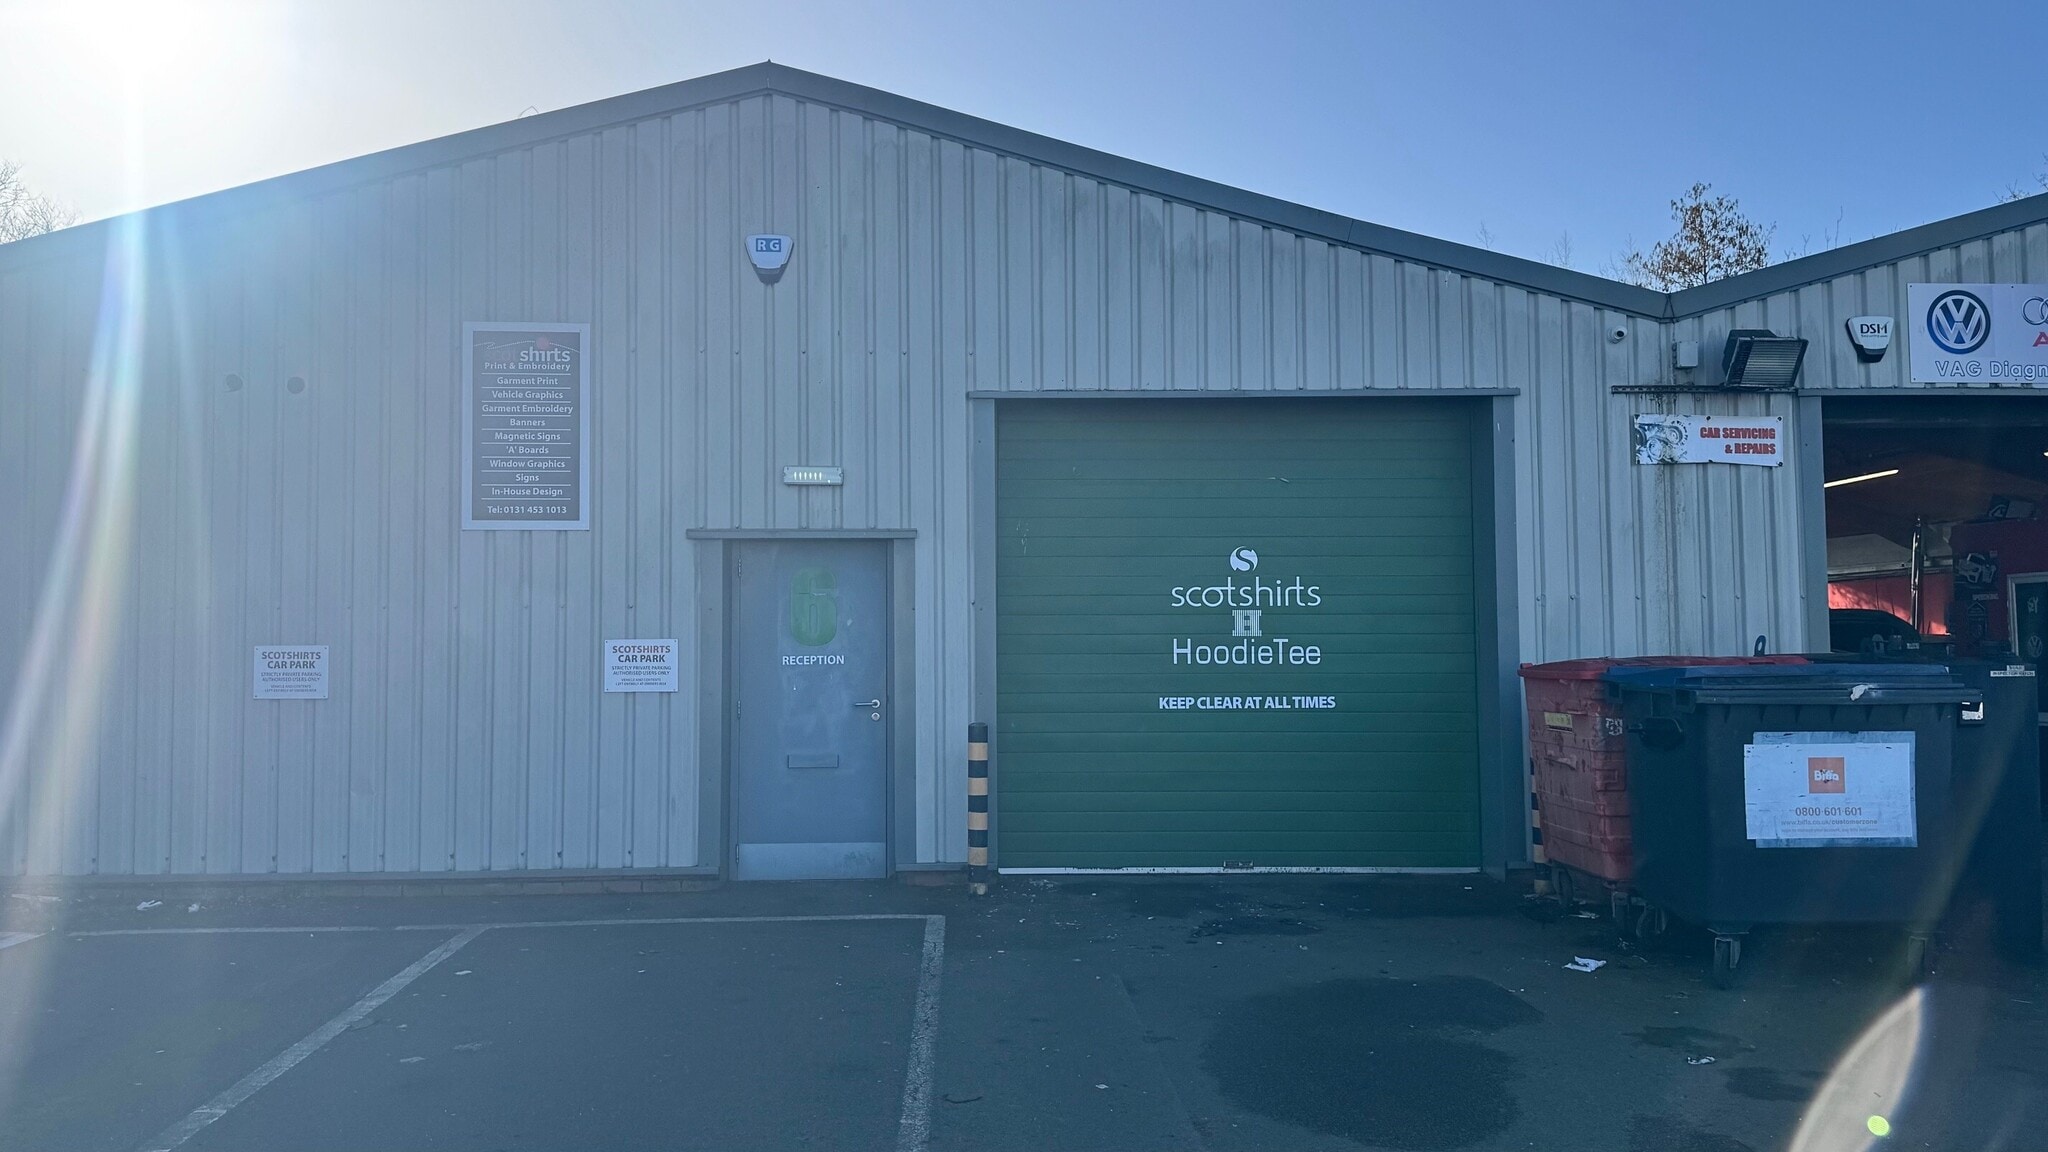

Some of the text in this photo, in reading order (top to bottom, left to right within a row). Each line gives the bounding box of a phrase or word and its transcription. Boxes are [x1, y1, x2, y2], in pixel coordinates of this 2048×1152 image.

[484, 362, 571, 371] Print & Embroidery
[1935, 360, 1982, 377] VAG
[497, 376, 558, 385] Garment Print
[492, 390, 563, 401] Vehicle Graphics
[482, 404, 573, 415] Garment Embroidery
[510, 418, 546, 427] Banners
[494, 432, 561, 442] Magnetic Signs
[1700, 427, 1776, 440] CAR SERVICING
[506, 446, 549, 454] 'A' Boards
[1725, 443, 1776, 455] & REPAIRS
[490, 460, 566, 470] Window Graphics
[515, 474, 540, 483] Signs
[492, 487, 563, 497] In-House Design
[487, 506, 567, 514] Tel: 0131 453 1013
[1171, 576, 1321, 607] scotshirts
[790, 567, 838, 647] 6
[612, 645, 671, 654] SCOTSHIRTS
[1173, 638, 1321, 665] HoodieTee
[261, 651, 321, 660] SCOTSHIRTS
[618, 654, 666, 663] CAR PARK
[267, 660, 316, 669] CAR PARK
[782, 656, 845, 665] RECEPTION
[1159, 696, 1336, 709] KEEP CLEAR AT ALL TIMES
[1795, 807, 1862, 816] 0800 601 601
